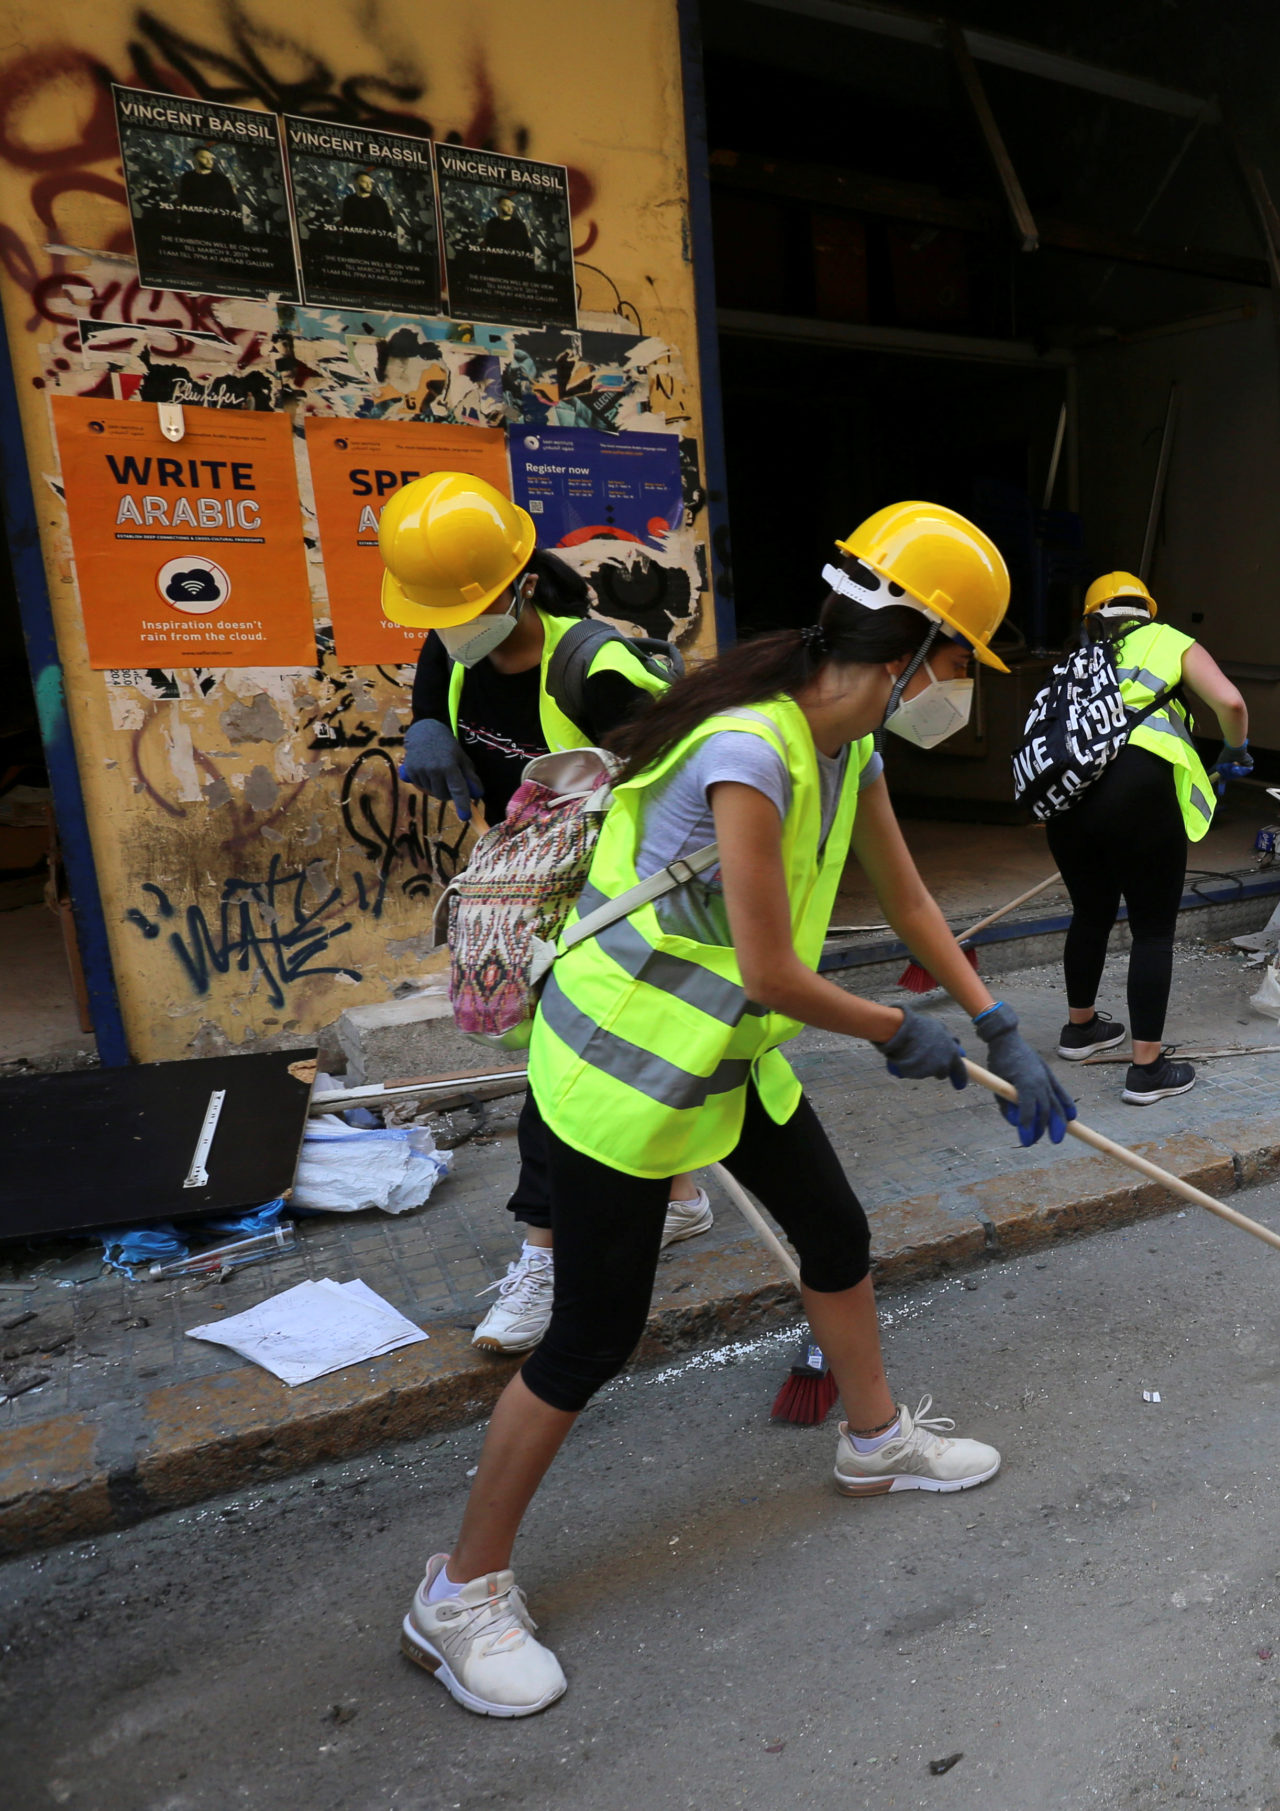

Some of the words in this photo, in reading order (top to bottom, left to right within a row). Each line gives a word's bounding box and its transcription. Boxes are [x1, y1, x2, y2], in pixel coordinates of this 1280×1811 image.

[119, 101, 204, 128] VINCENT
[208, 116, 276, 140] BASSIL
[290, 129, 364, 155] VINCENT
[369, 143, 428, 165] BASSIL
[440, 156, 507, 180] VINCENT
[511, 169, 564, 190] BASSIL
[105, 454, 256, 491] WRITE
[525, 462, 566, 475] Register
[568, 467, 590, 475] now
[115, 494, 262, 530] ARABIC
[140, 632, 167, 641] rain
[171, 632, 202, 641] from
[205, 632, 225, 641] the
[229, 632, 267, 641] cloud.
[142, 620, 213, 632] Inspiration
[217, 620, 263, 630] doesn't
[404, 631, 415, 639] to
